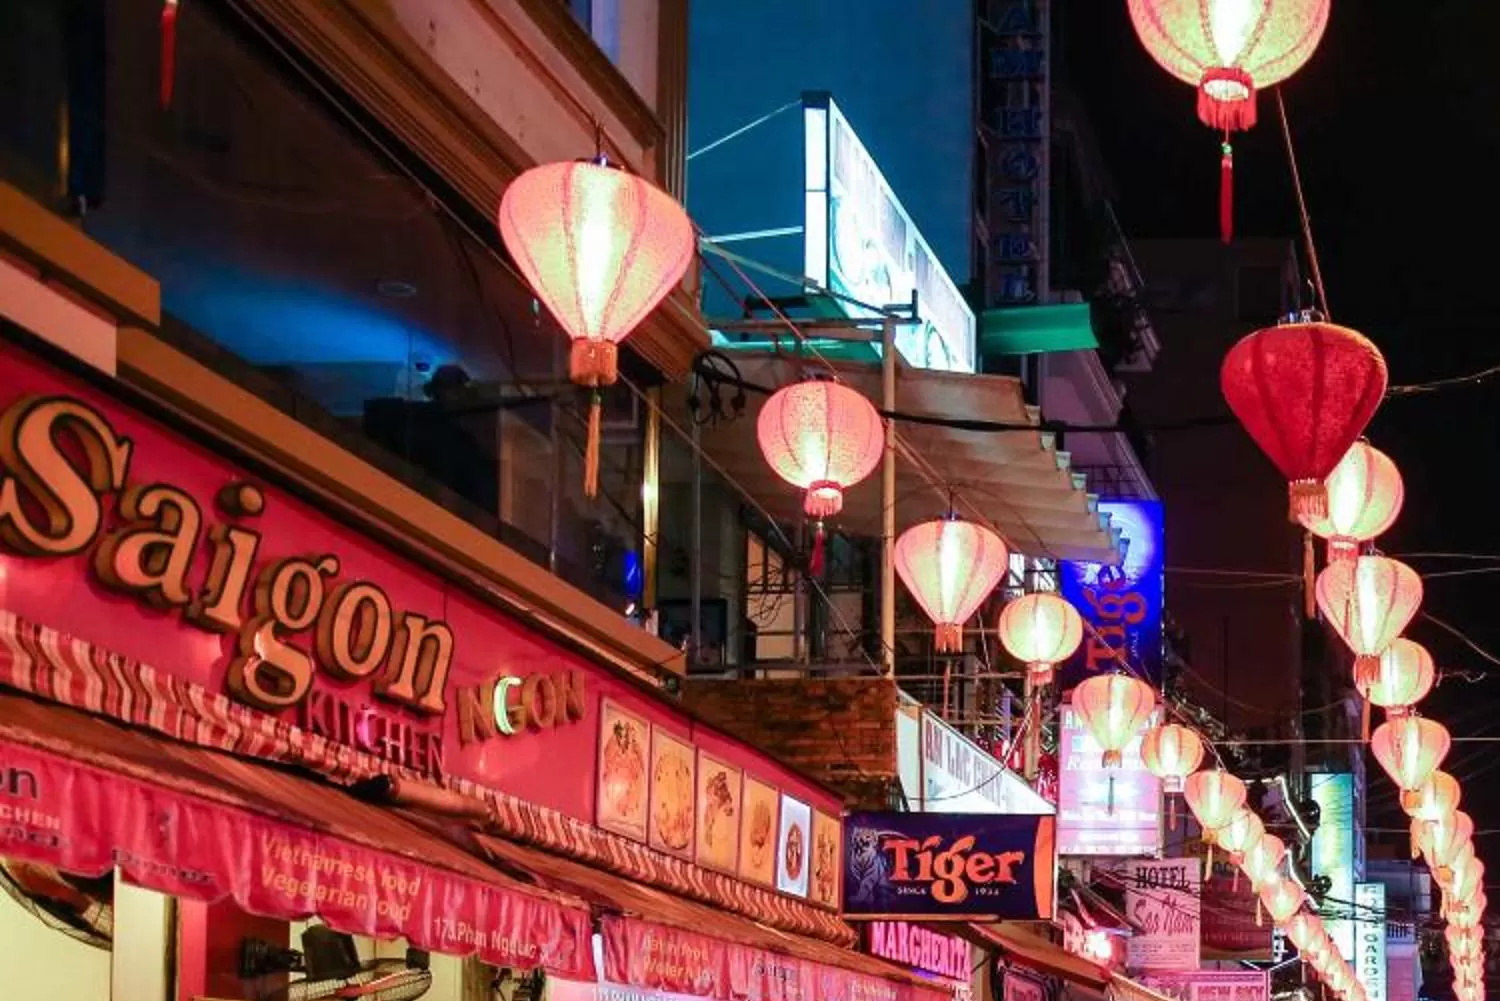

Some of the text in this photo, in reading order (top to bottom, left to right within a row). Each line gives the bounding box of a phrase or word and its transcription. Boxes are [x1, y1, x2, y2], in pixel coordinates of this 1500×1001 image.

[0, 396, 455, 715] Saigon
[262, 863, 368, 911] Vegearian
[881, 835, 1025, 903] Tiger
[1136, 866, 1190, 889] HOTEL
[872, 921, 971, 981] MARGHERITA
